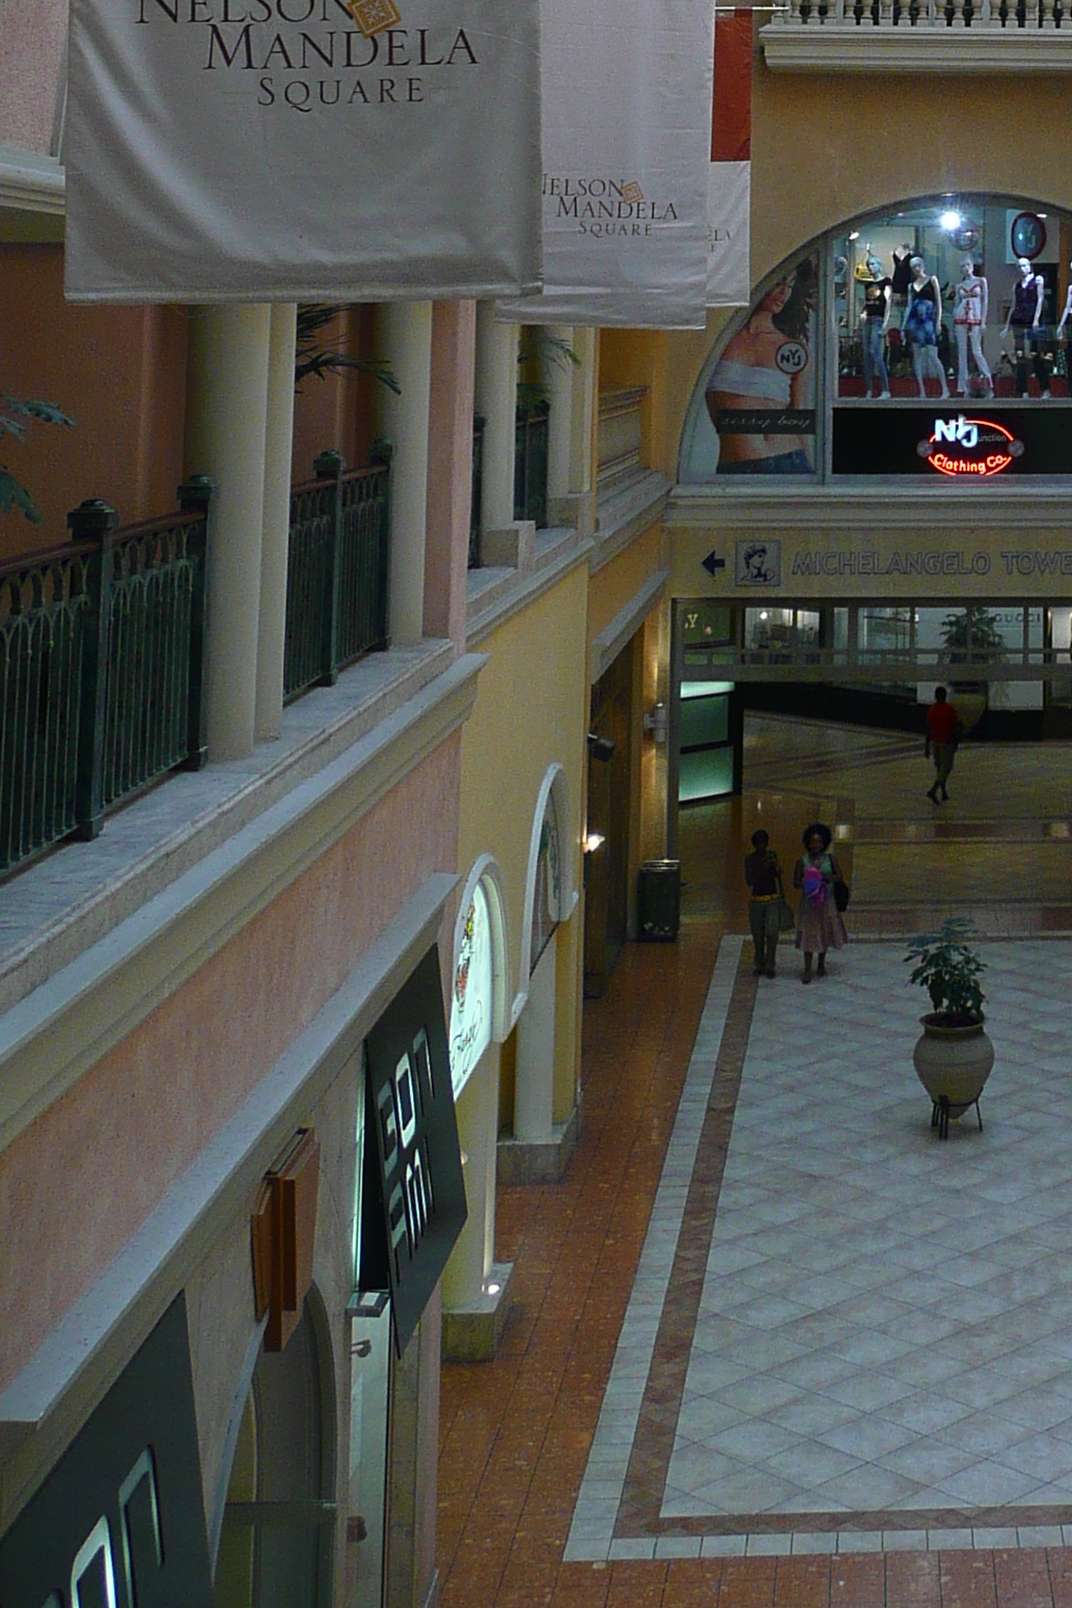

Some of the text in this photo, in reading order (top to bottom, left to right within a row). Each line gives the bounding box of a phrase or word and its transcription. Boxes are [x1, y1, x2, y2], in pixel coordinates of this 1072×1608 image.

[202, 23, 481, 70] MANDELA
[257, 77, 425, 113] SQUARE
[556, 196, 678, 220] MANDELA
[578, 220, 653, 238] SQUARE
[933, 453, 986, 475] Clothing
[791, 550, 991, 575] MICHELANGELO
[994, 612, 1041, 624] GUCCI
